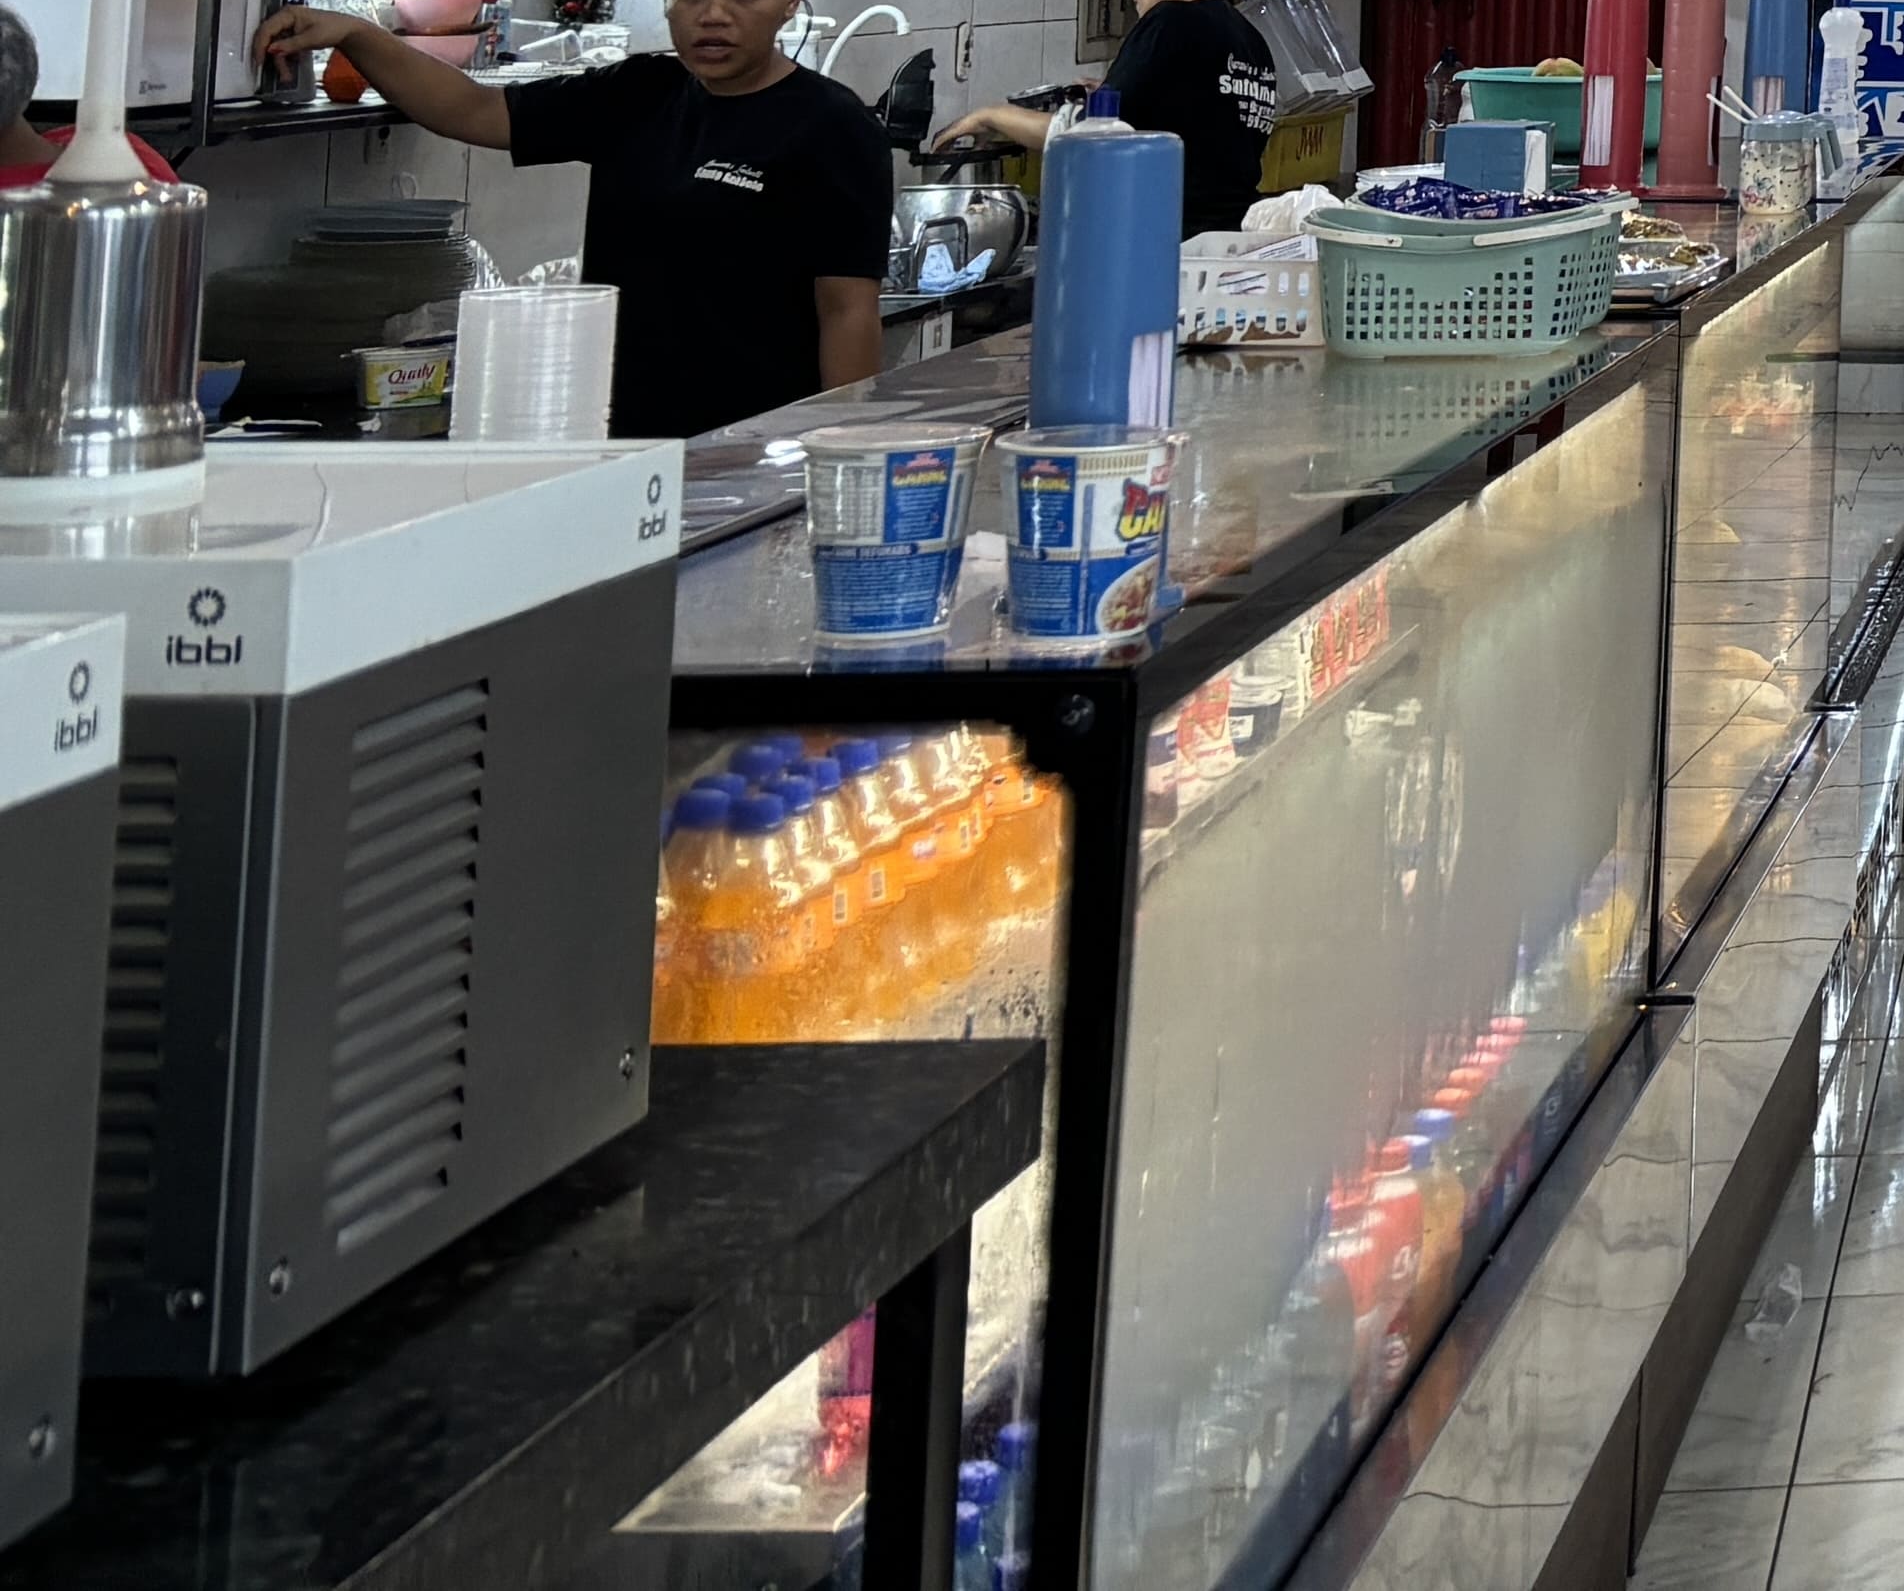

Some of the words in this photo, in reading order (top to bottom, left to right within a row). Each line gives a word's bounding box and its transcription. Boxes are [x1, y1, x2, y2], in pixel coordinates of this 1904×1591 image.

[638, 509, 668, 542] ibbl
[166, 634, 242, 666] ibbl
[54, 706, 98, 752] ibbl
